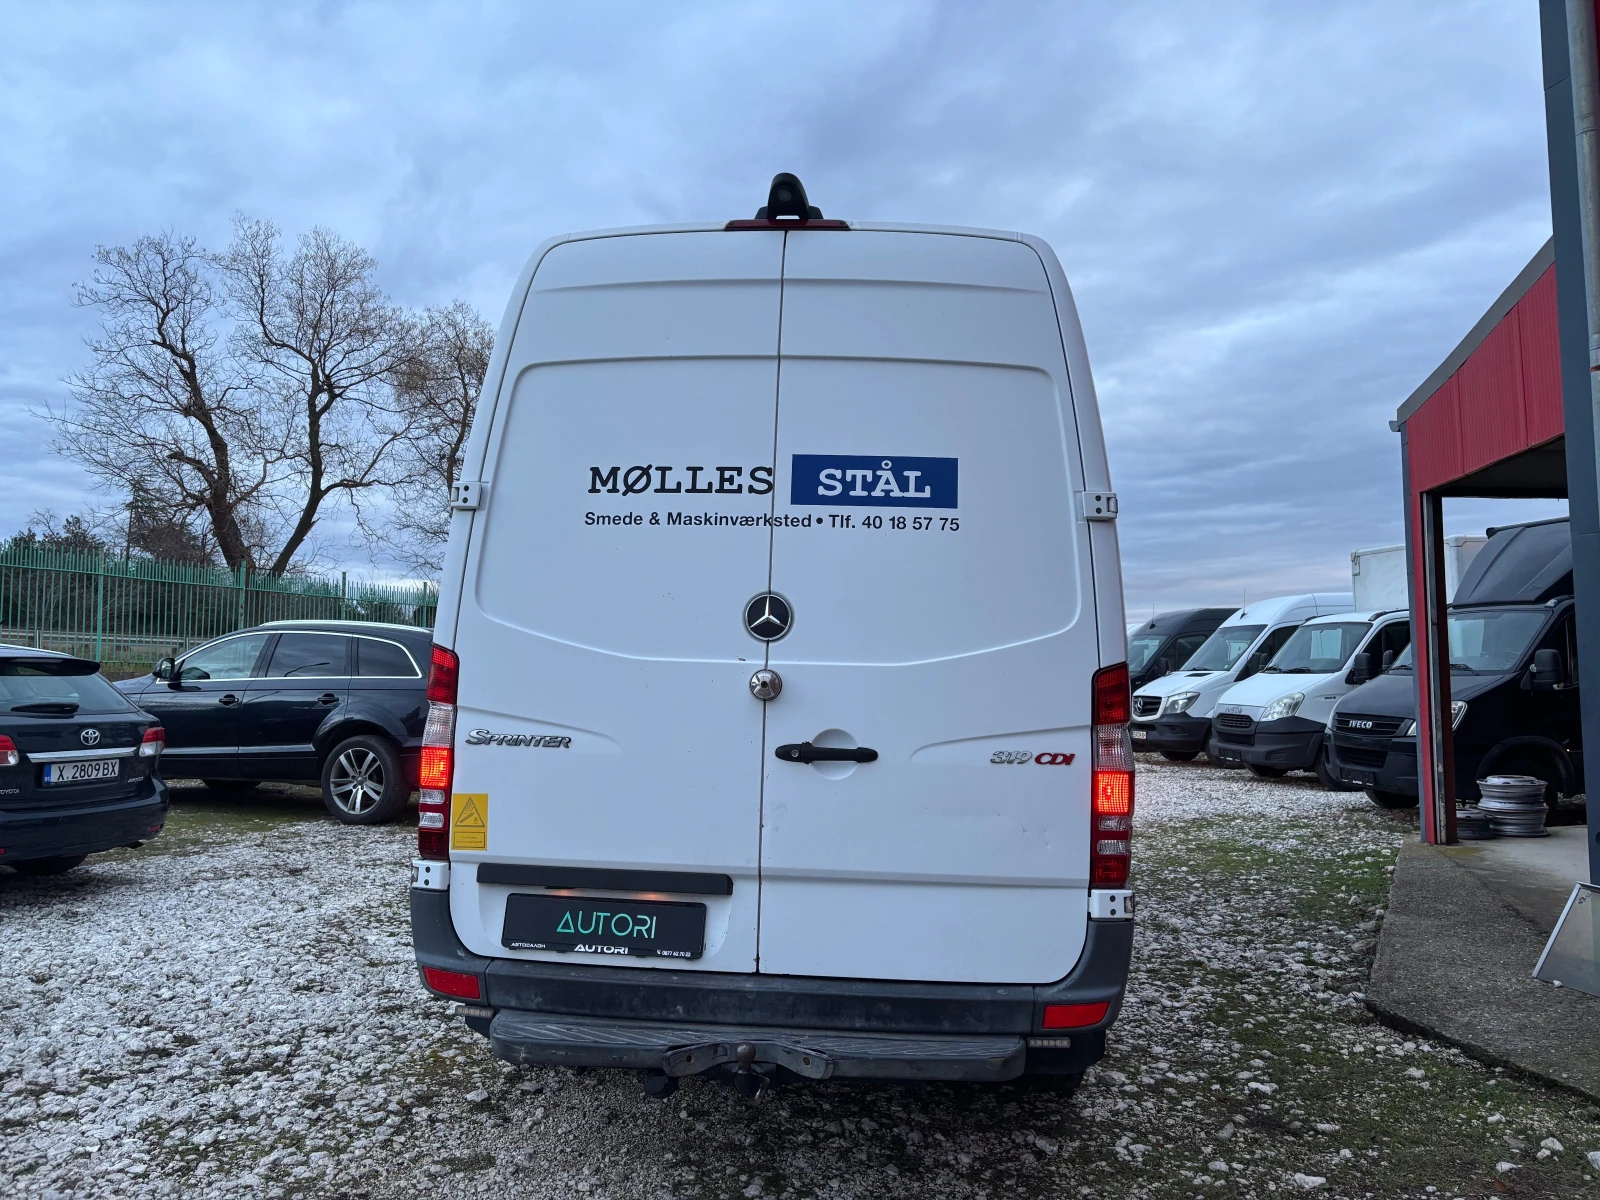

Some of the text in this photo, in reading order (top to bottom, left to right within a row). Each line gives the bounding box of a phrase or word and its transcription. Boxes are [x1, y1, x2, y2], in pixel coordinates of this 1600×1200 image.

[588, 460, 931, 498] MØLLES STÅL
[584, 511, 960, 532] Smede & Maskinværksted Tlf. 40 18 57 75
[1349, 720, 1373, 729] IVECO
[990, 750, 1076, 765] 319 CDI
[556, 910, 657, 939] AUTORI
[574, 943, 629, 955] AUTORI
